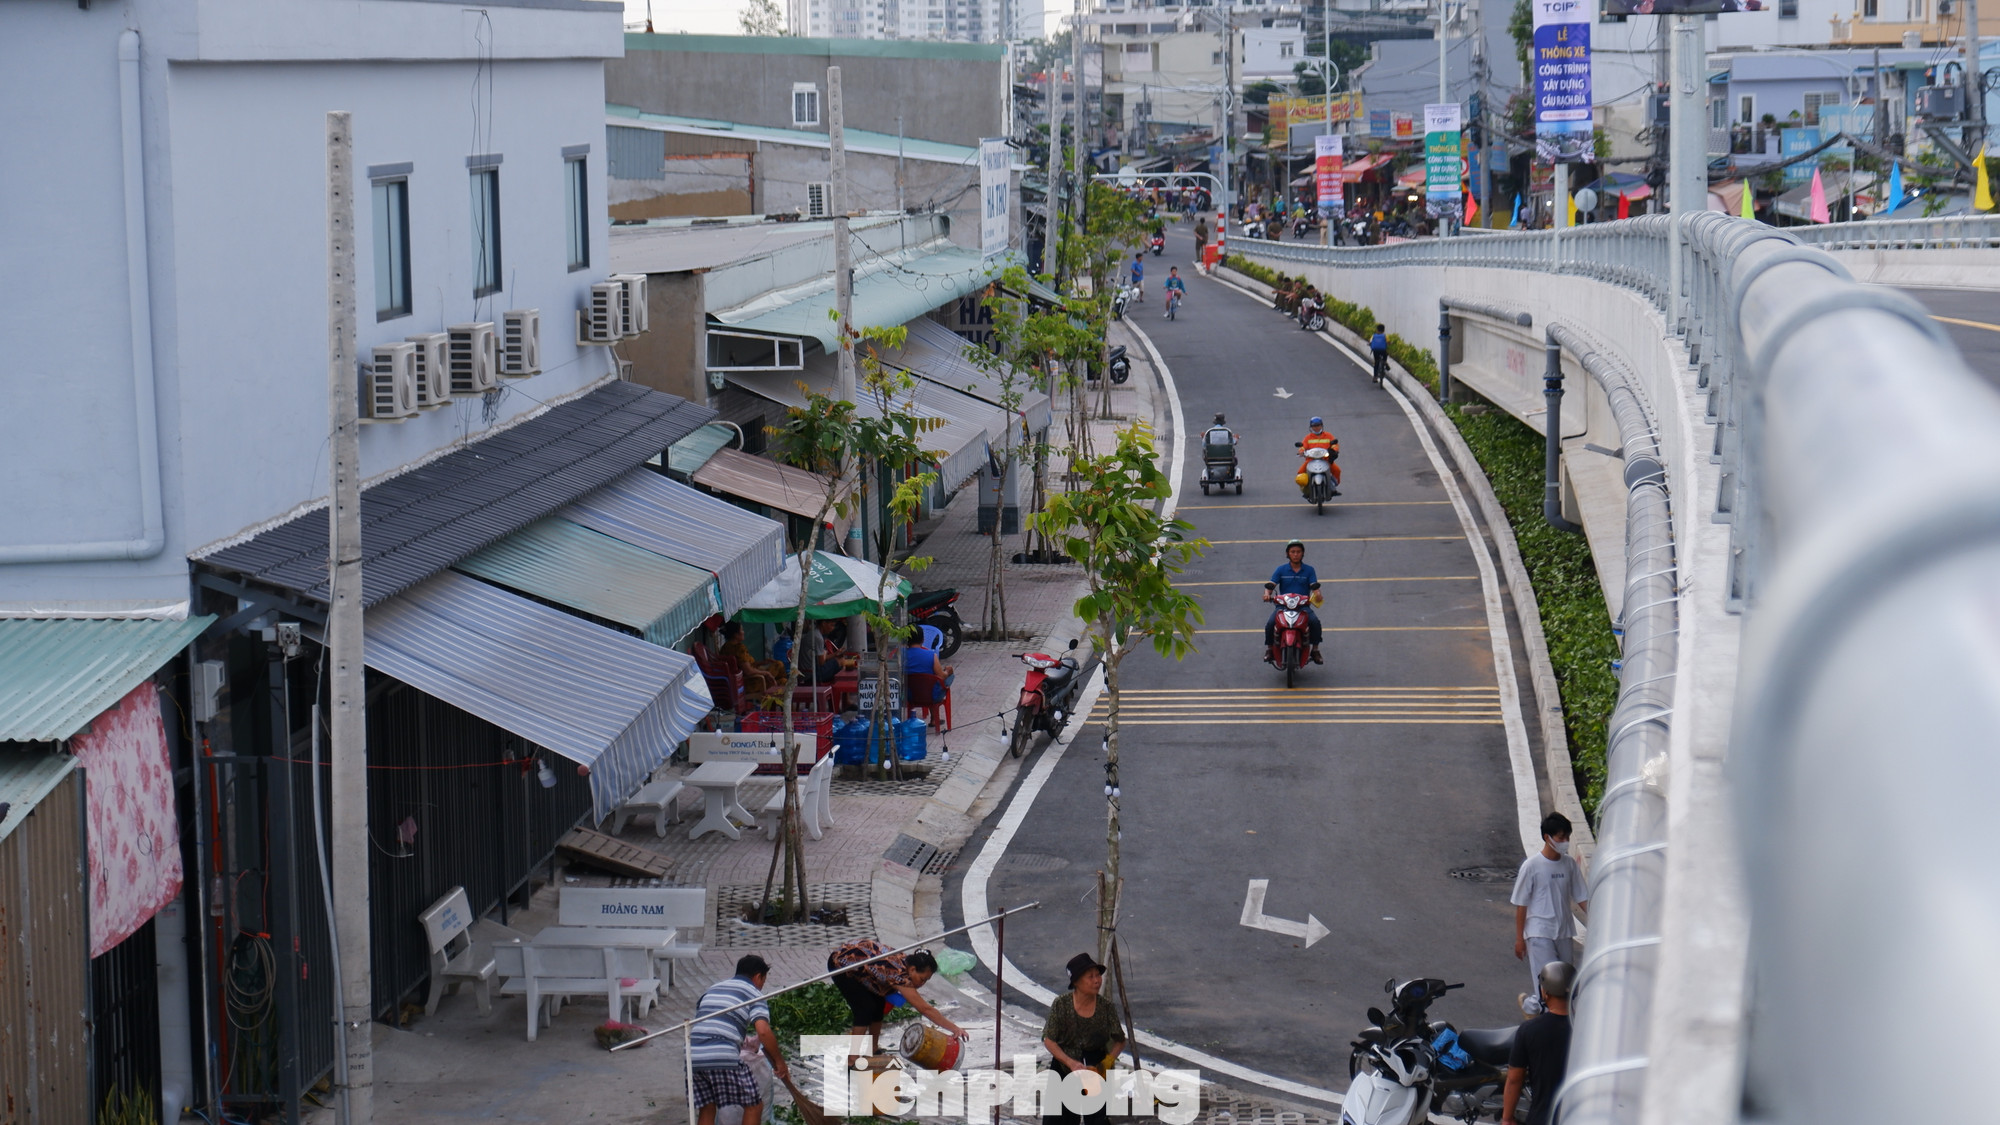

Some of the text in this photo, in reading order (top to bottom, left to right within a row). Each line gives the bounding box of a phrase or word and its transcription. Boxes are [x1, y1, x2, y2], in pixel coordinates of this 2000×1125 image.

[1557, 26, 1568, 41] LỄ
[1540, 45, 1586, 59] THÔNG XE
[1539, 61, 1588, 77] CÔNG TRÌNH
[1543, 78, 1584, 94] XÂY DỰNG
[1542, 94, 1556, 107] CẦU
[1557, 95, 1574, 109] RẠCH
[601, 902, 665, 915] HOÀNG NAM
